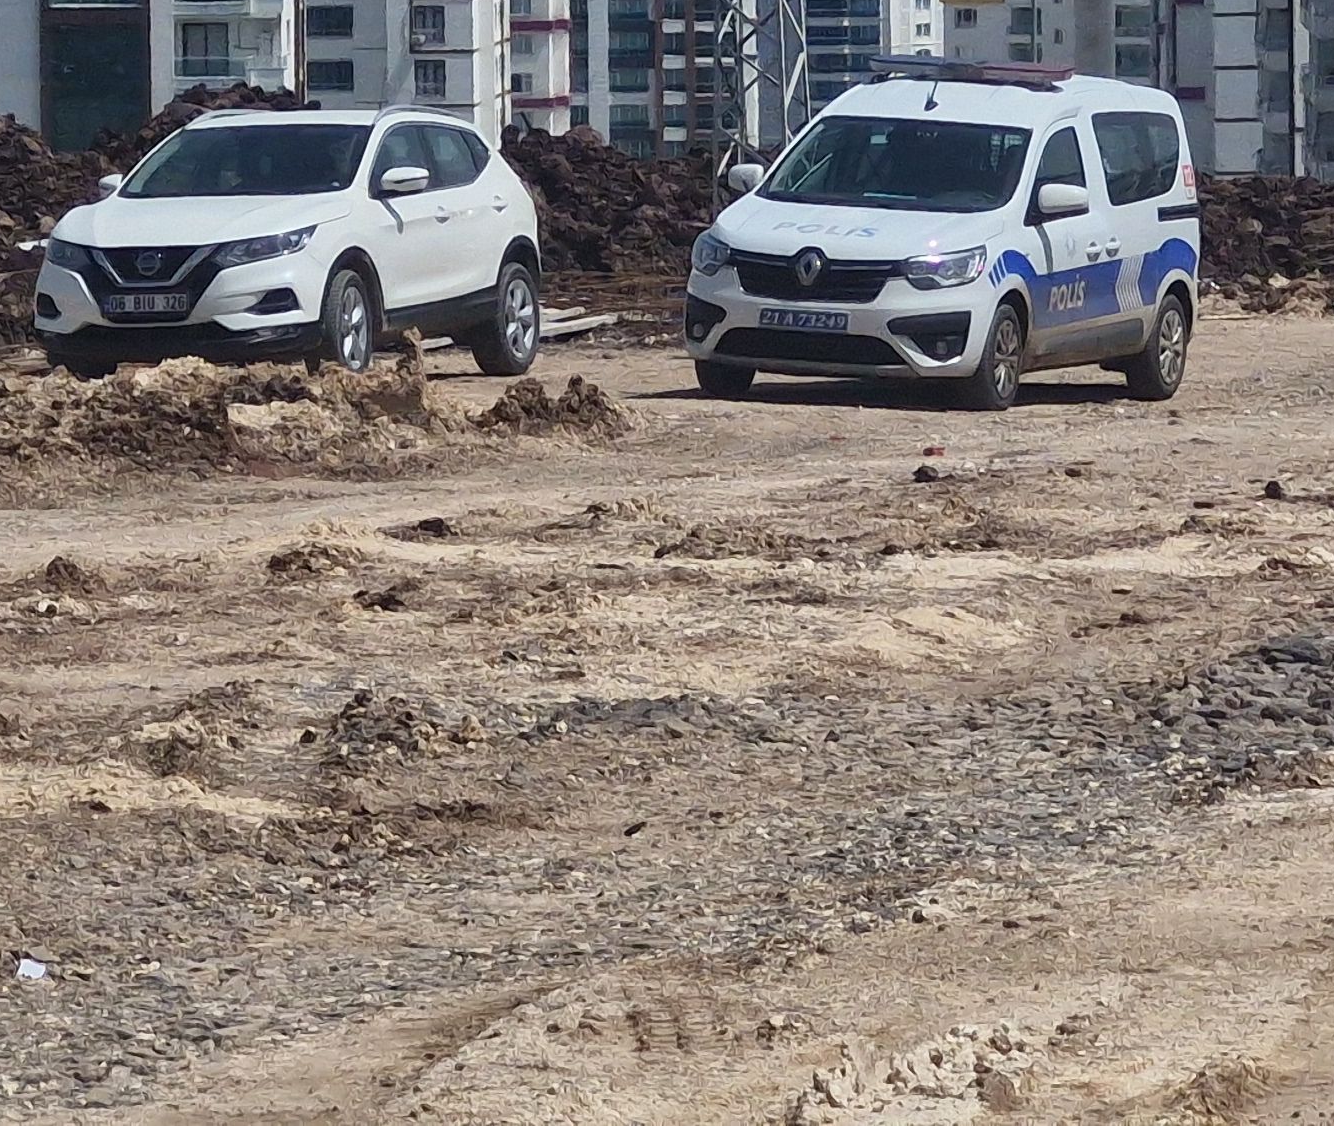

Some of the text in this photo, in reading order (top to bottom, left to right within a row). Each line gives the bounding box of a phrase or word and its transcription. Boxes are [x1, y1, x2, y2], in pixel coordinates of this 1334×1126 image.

[111, 296, 126, 311] 06
[761, 310, 779, 324] 21
[782, 312, 794, 325] A
